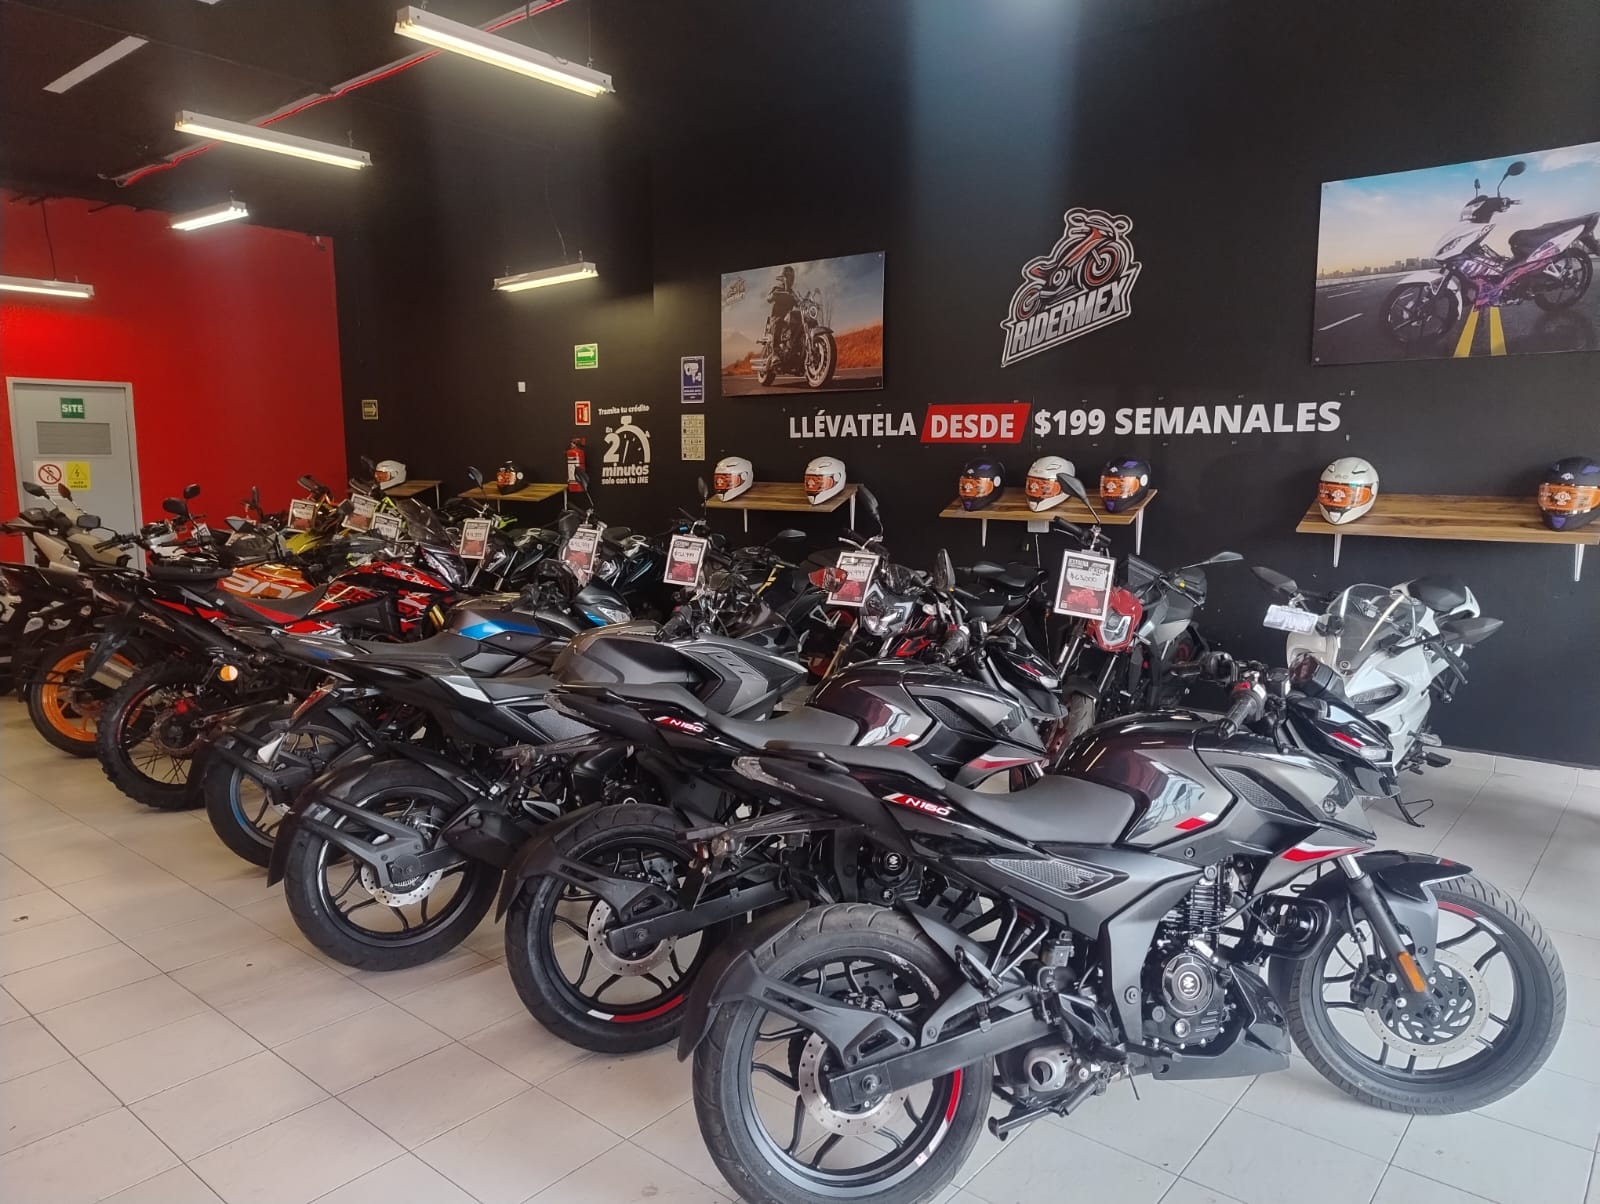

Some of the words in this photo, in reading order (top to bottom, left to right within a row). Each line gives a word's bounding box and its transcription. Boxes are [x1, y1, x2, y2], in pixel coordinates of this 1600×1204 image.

[1010, 278, 1128, 355] RIDERMEX
[61, 404, 84, 413] SITE
[598, 406, 620, 415] Tramita
[628, 404, 650, 413] crédito
[789, 410, 917, 438] LLÉVATELA
[930, 413, 1015, 438] DESDE
[1034, 408, 1106, 437] $199
[1114, 401, 1342, 435] SEMANALES
[603, 432, 620, 463] 2
[602, 462, 649, 477] minutos
[905, 797, 950, 816] N160
